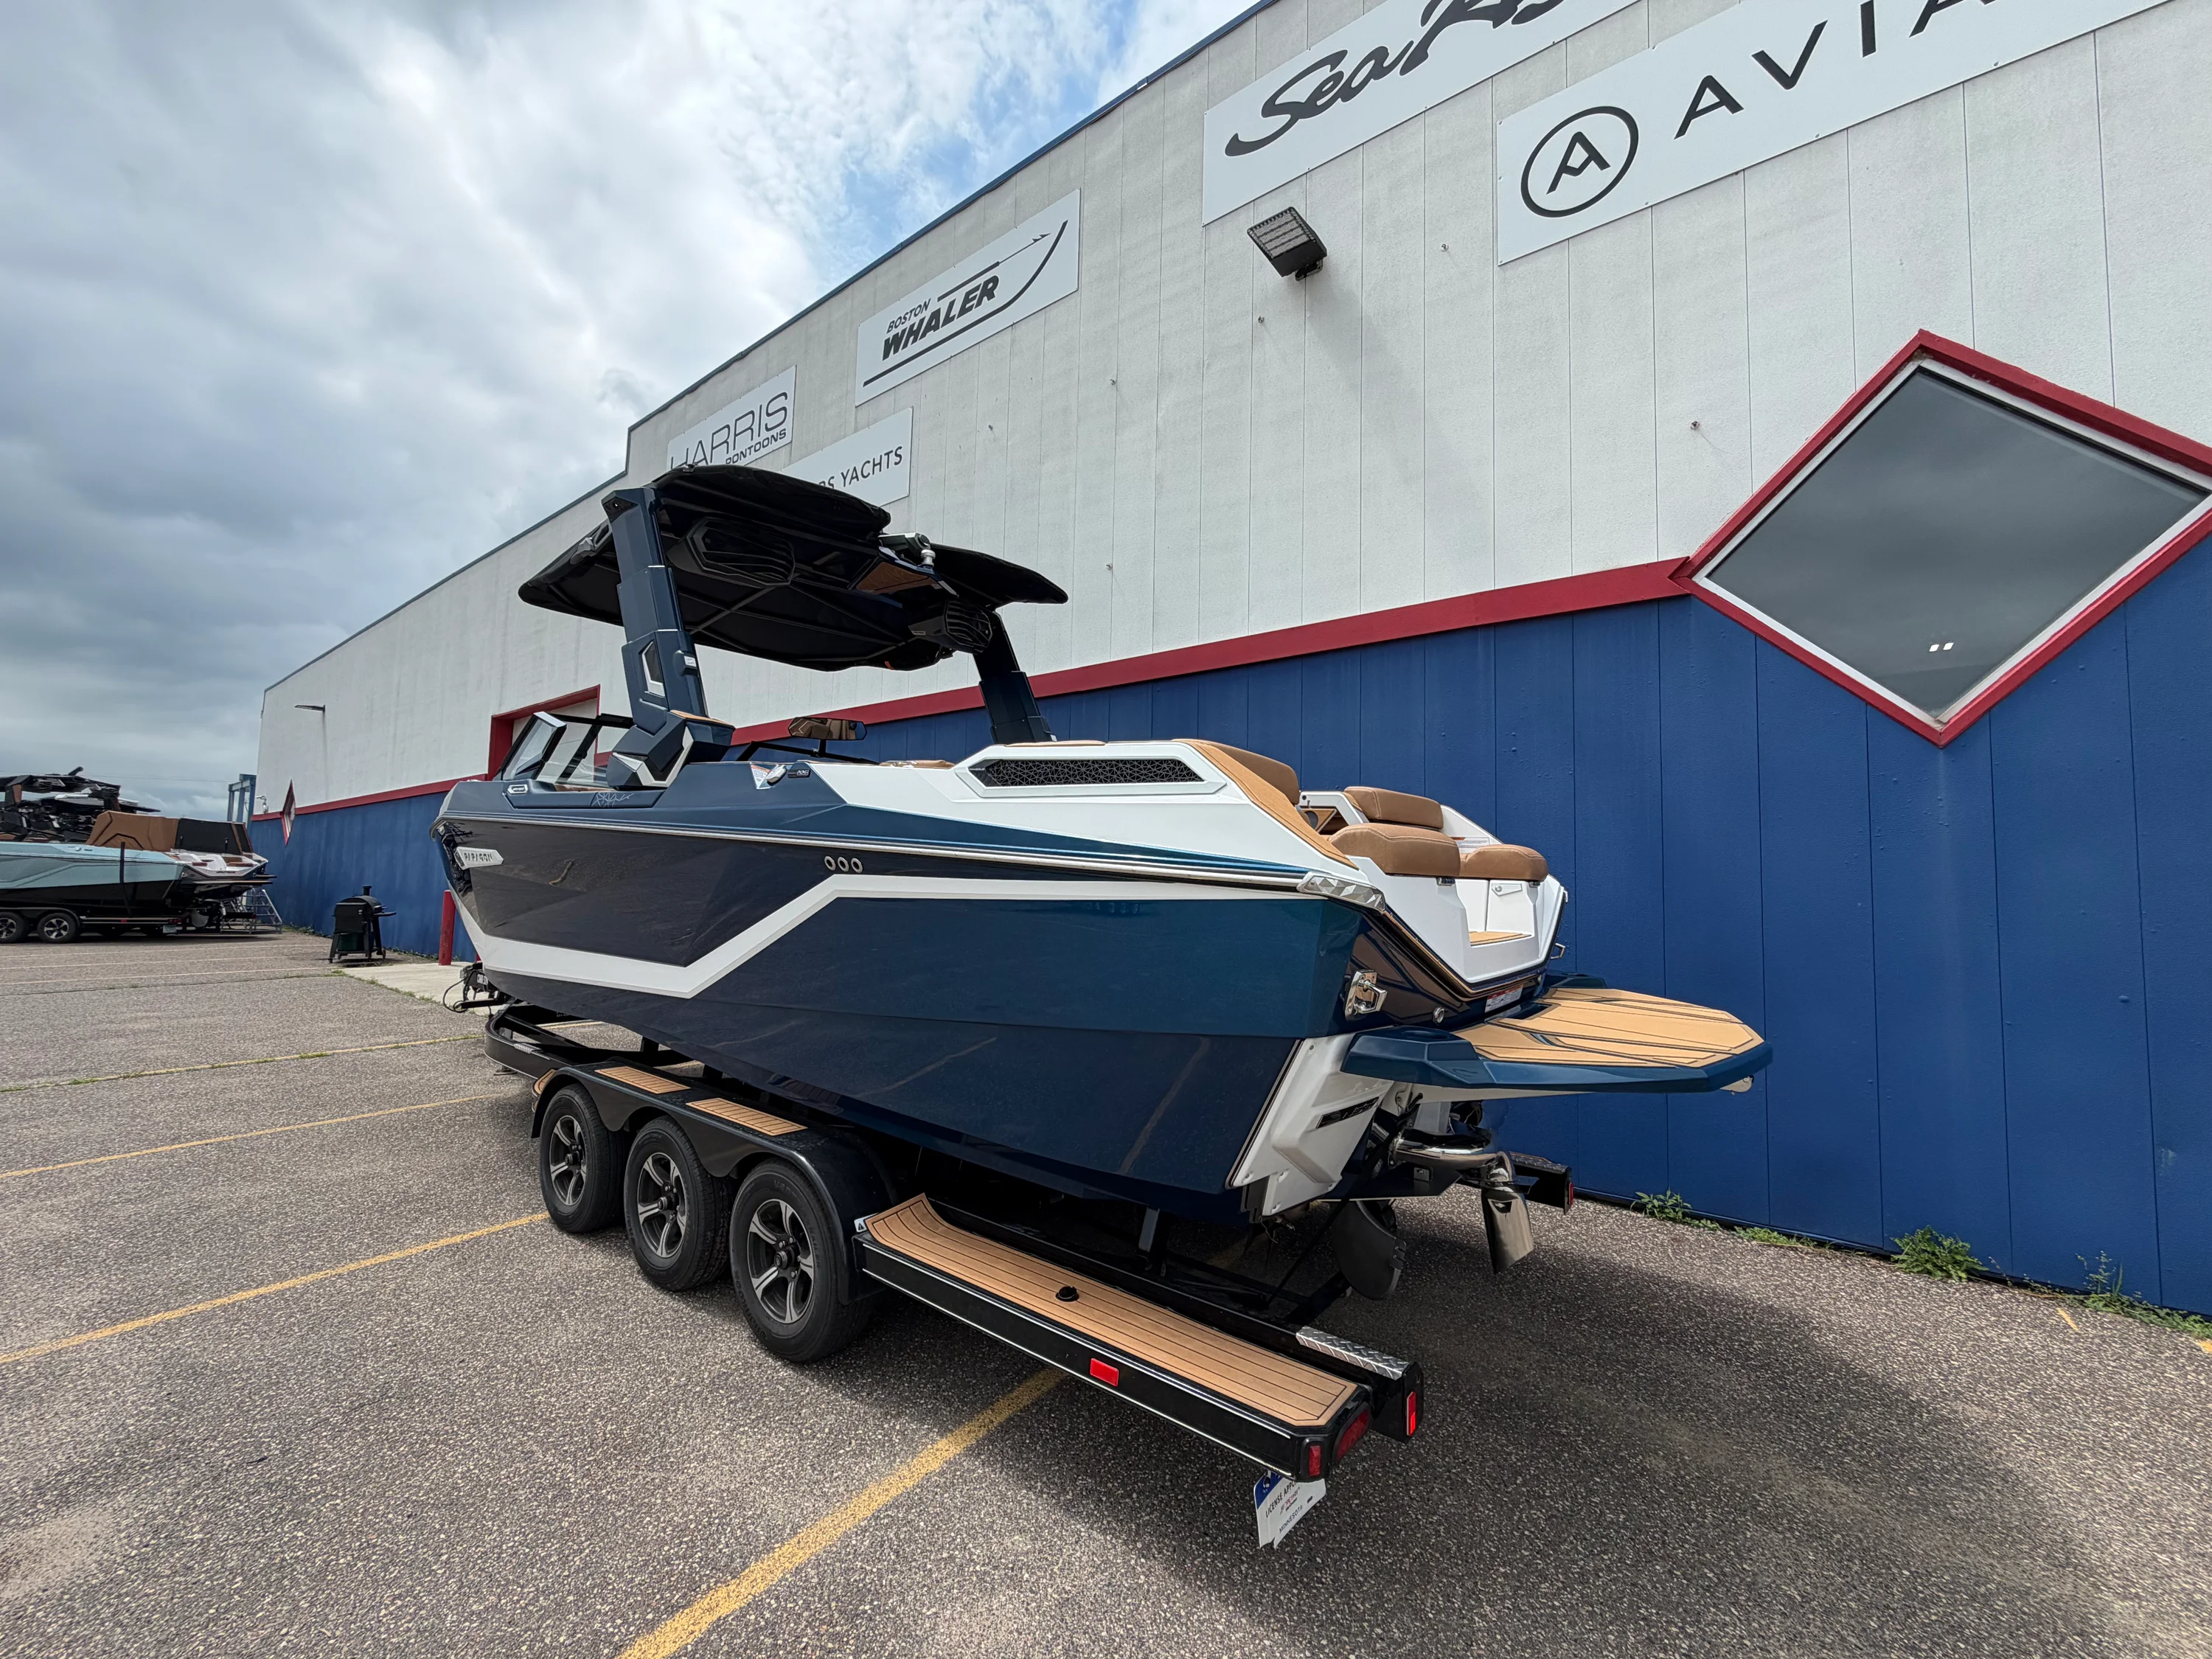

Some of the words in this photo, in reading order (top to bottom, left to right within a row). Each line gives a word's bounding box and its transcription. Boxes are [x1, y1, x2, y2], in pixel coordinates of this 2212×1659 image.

[1225, 41, 1414, 156] Sea
[882, 275, 999, 361] WHALER
[886, 298, 931, 334] BOSTON
[725, 428, 787, 465] PONTOONS
[841, 445, 903, 487] YACHTS
[1265, 1492, 1283, 1518] LICENSE
[1279, 1504, 1303, 1534] MINNESOTA
